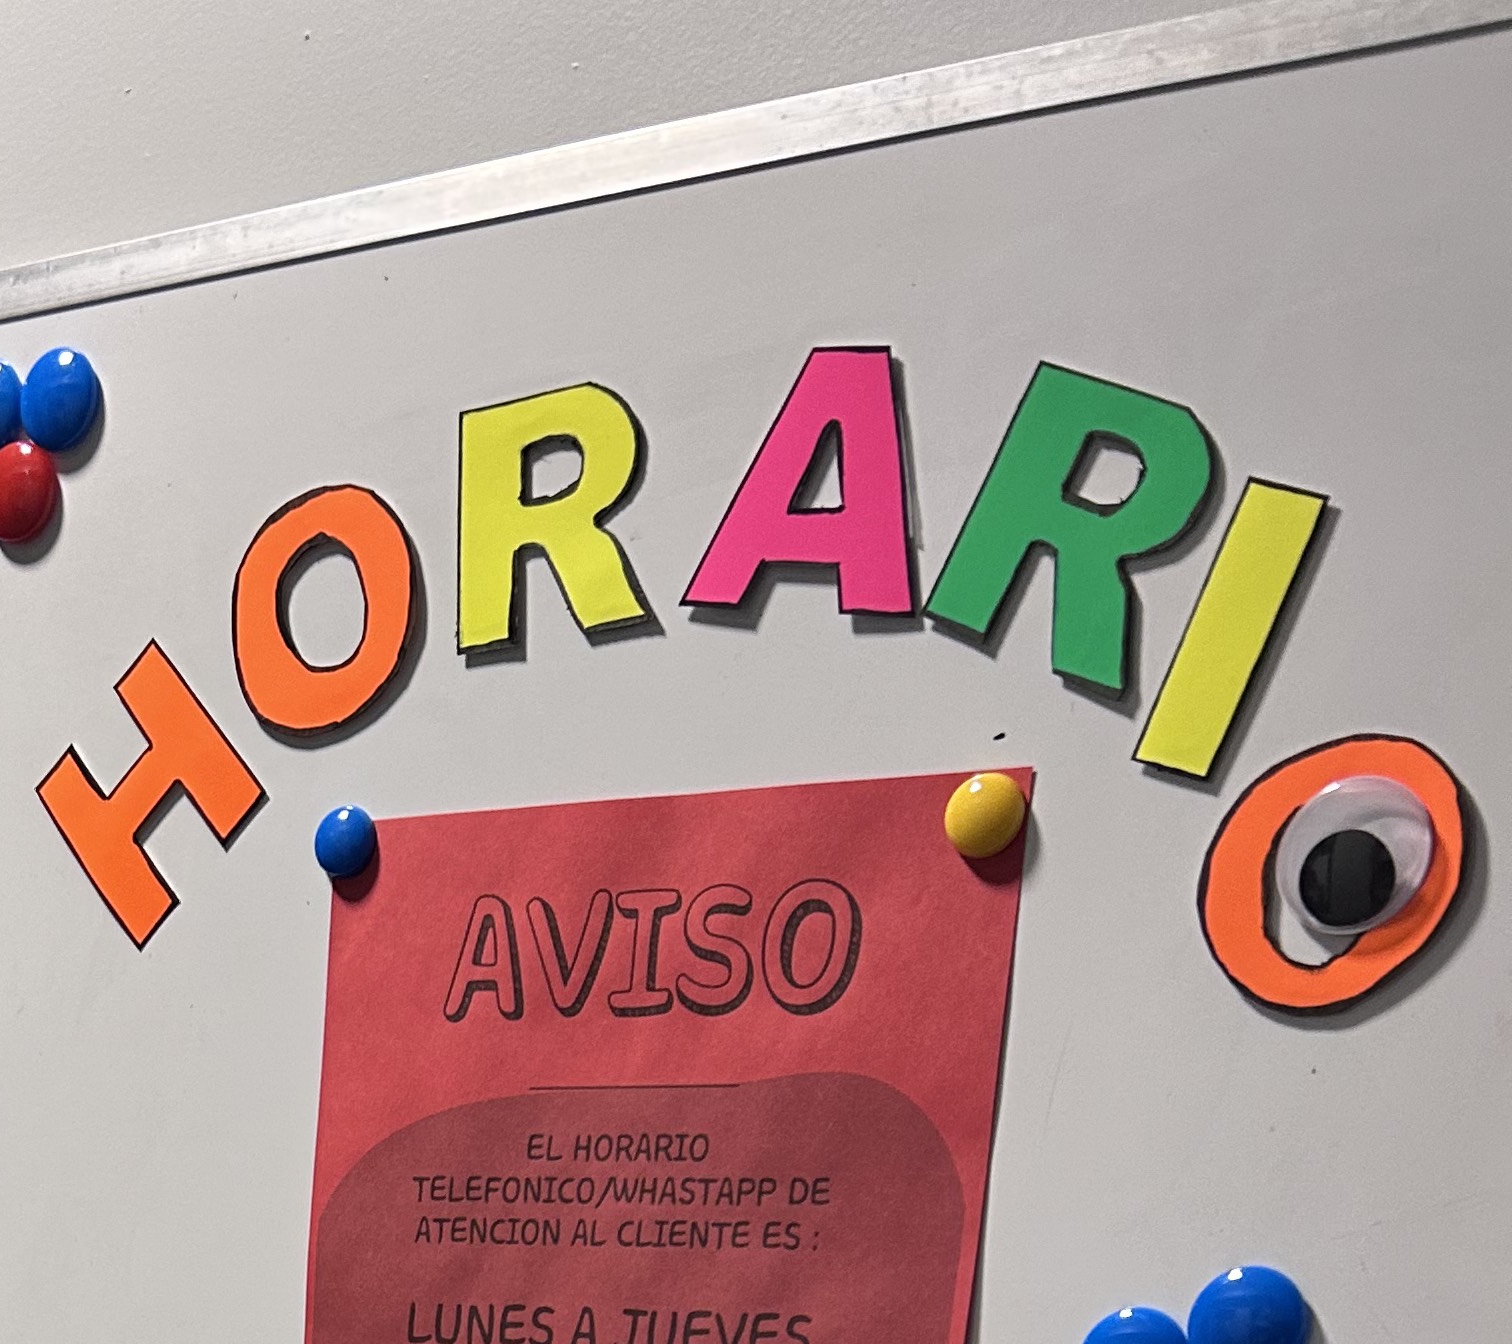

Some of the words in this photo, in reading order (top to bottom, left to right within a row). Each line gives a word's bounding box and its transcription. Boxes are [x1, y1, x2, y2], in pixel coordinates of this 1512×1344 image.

[36, 345, 1467, 1011] HORARIO
[443, 877, 862, 1022] AVISO
[527, 1133, 562, 1160] EL
[574, 1133, 709, 1162] HORARIO
[413, 1176, 777, 1208] TELEFONICO/WHASTAPP
[788, 1177, 830, 1205] DE
[414, 1216, 561, 1246] ATENCION
[571, 1219, 606, 1247] AL
[617, 1220, 749, 1249] CLIENTE
